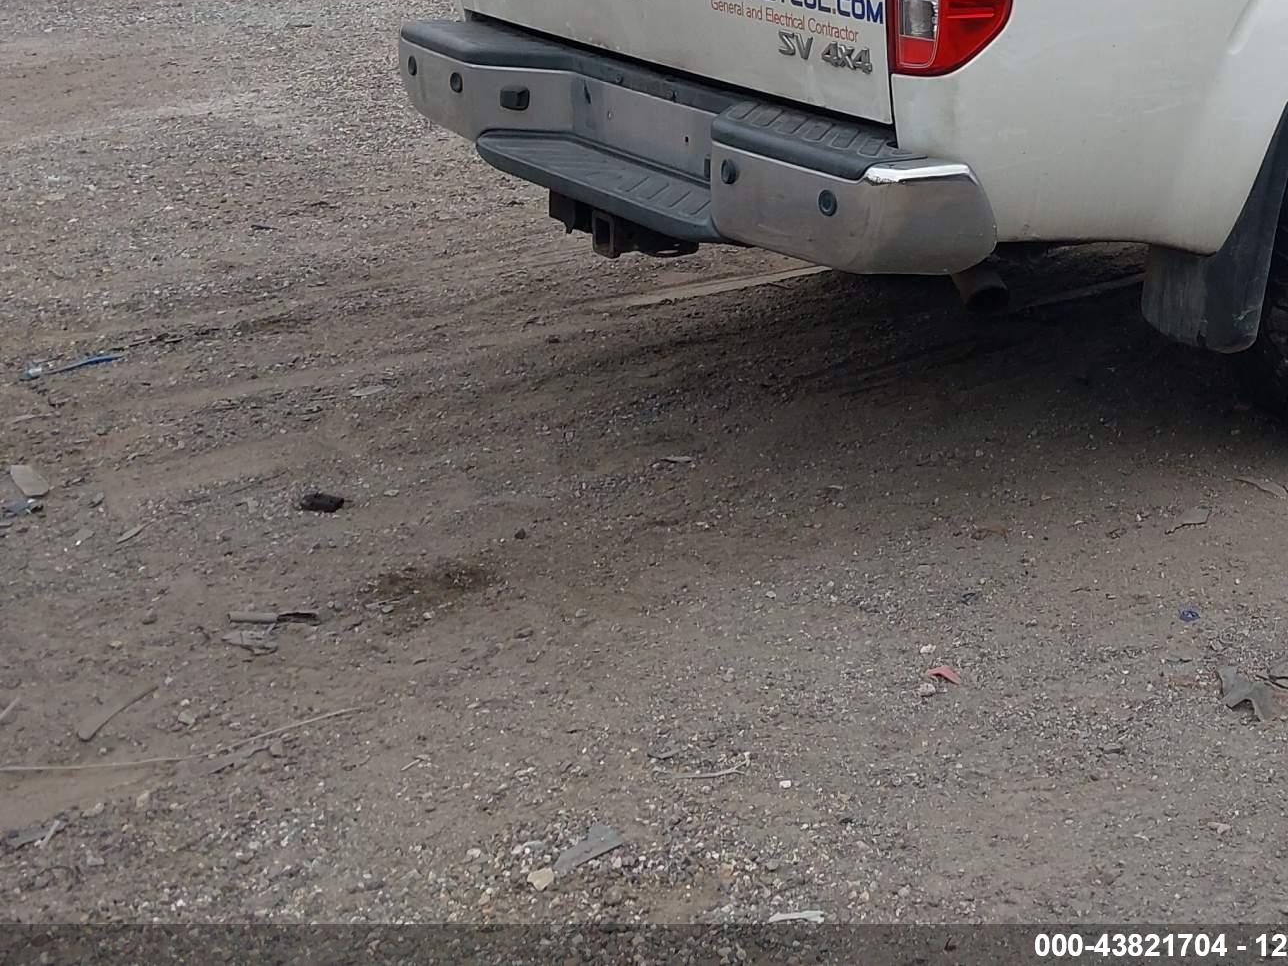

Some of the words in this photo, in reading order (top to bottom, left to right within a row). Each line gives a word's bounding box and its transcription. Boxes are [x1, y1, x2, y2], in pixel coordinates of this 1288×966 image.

[746, 4, 763, 21] and
[765, 6, 805, 31] Electrical
[807, 17, 859, 43] Contractor
[778, 30, 814, 61] SV
